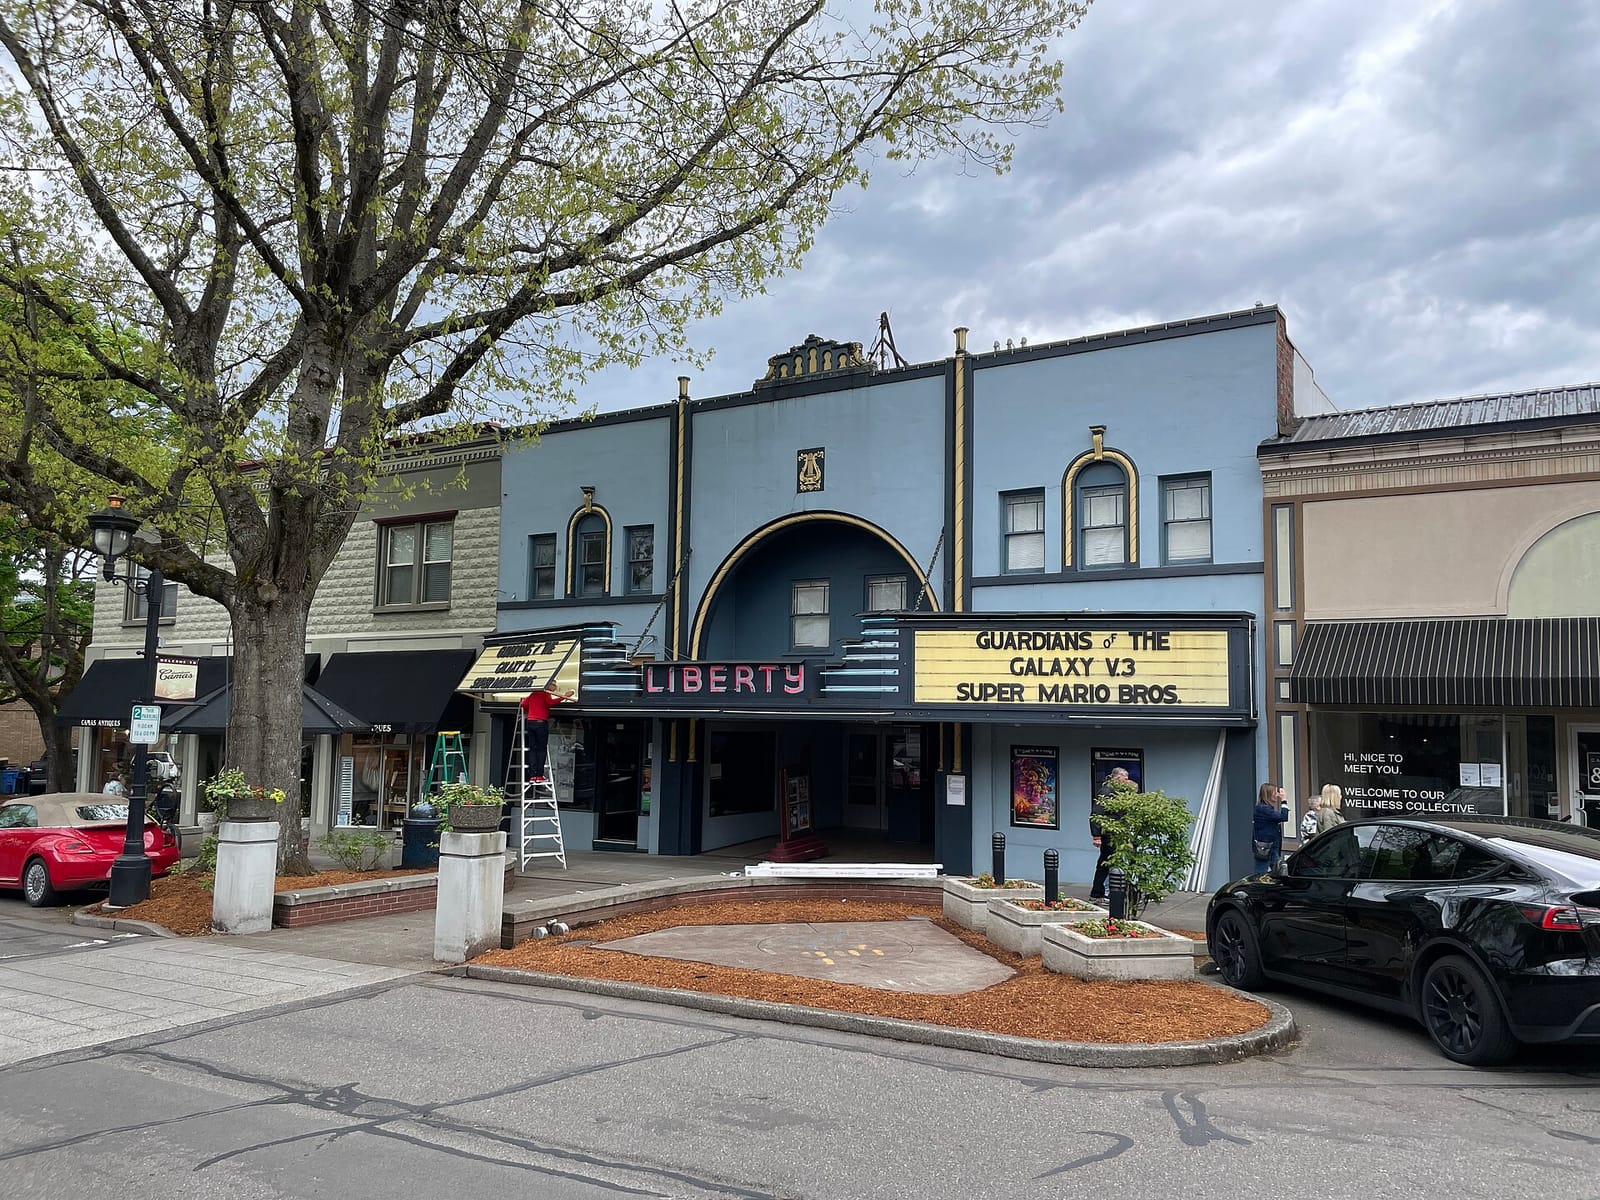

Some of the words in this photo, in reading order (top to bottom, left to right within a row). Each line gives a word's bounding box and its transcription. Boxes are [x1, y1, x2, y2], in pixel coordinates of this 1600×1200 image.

[976, 631, 1092, 650] GUARDIANS
[1129, 631, 1170, 651] THE
[1010, 657, 1094, 677] GALAXY
[1105, 658, 1135, 677] V.3
[159, 668, 193, 680] Camas
[647, 665, 805, 693] LIBERTY
[957, 683, 1024, 703] SUPER
[1039, 684, 1110, 703] MARIO
[1119, 684, 1182, 704] BROS.
[134, 708, 141, 719] 2
[98, 719, 121, 727] ANTIQUES
[1360, 753, 1386, 763] NICE
[1388, 754, 1403, 763] TO
[1344, 764, 1374, 774] MEET
[1376, 765, 1403, 775] YOU.
[1345, 787, 1400, 798] WELCOME
[1402, 789, 1418, 799] TO
[1419, 790, 1445, 800] OUR
[1345, 798, 1403, 810] WELLNESS
[1405, 801, 1479, 814] COLLECTIVE.
